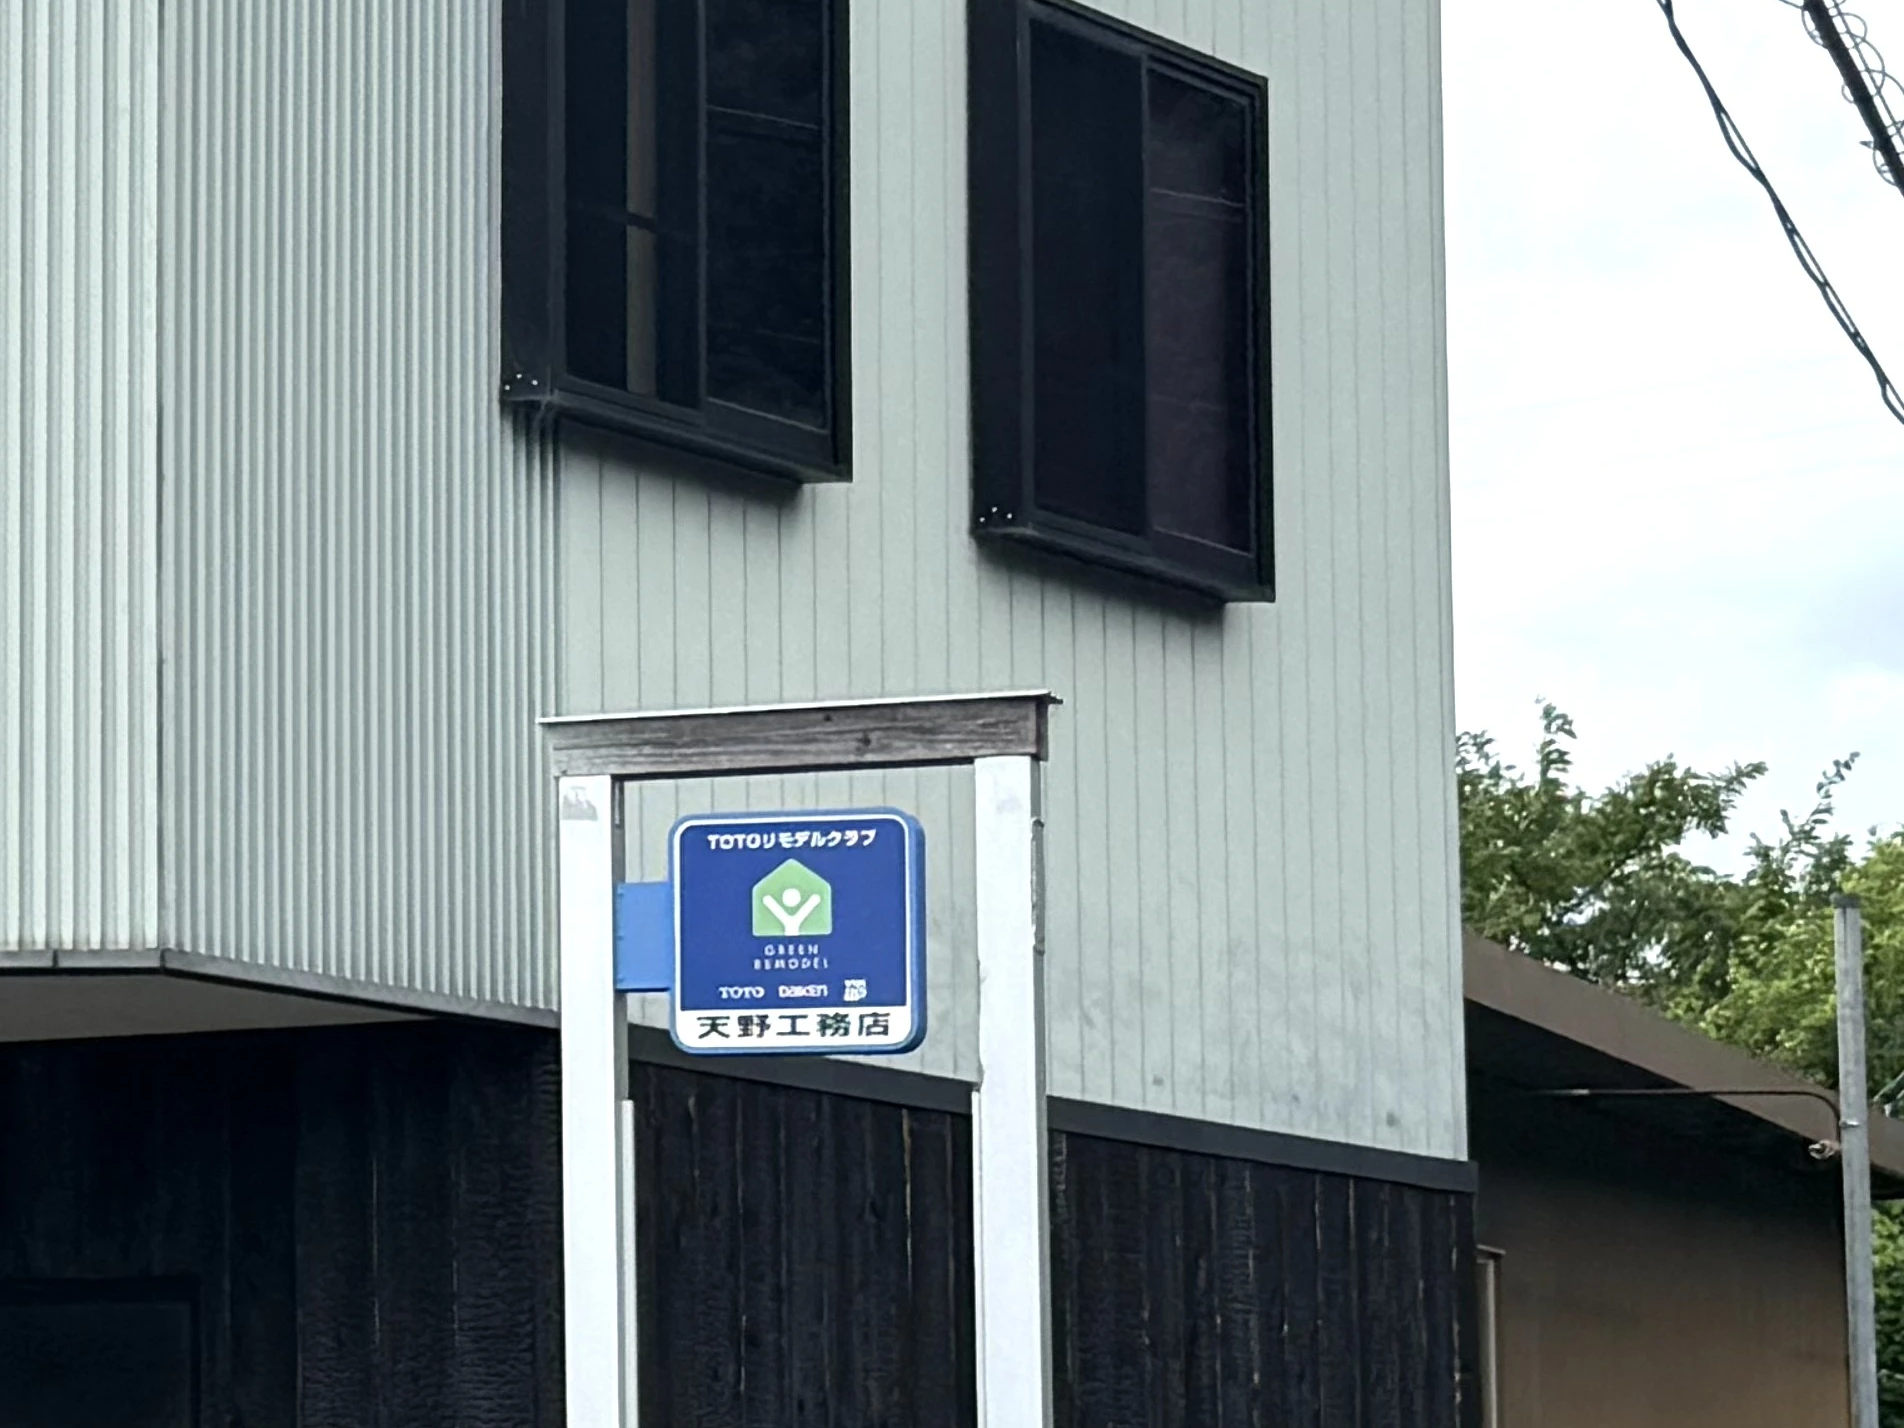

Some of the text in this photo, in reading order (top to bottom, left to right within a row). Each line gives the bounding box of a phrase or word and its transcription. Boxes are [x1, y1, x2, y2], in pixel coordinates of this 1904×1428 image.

[764, 943, 819, 956] GREEN
[753, 958, 829, 970] REMODEL
[718, 985, 766, 999] TOTO
[696, 1011, 892, 1040] 天野工務店
